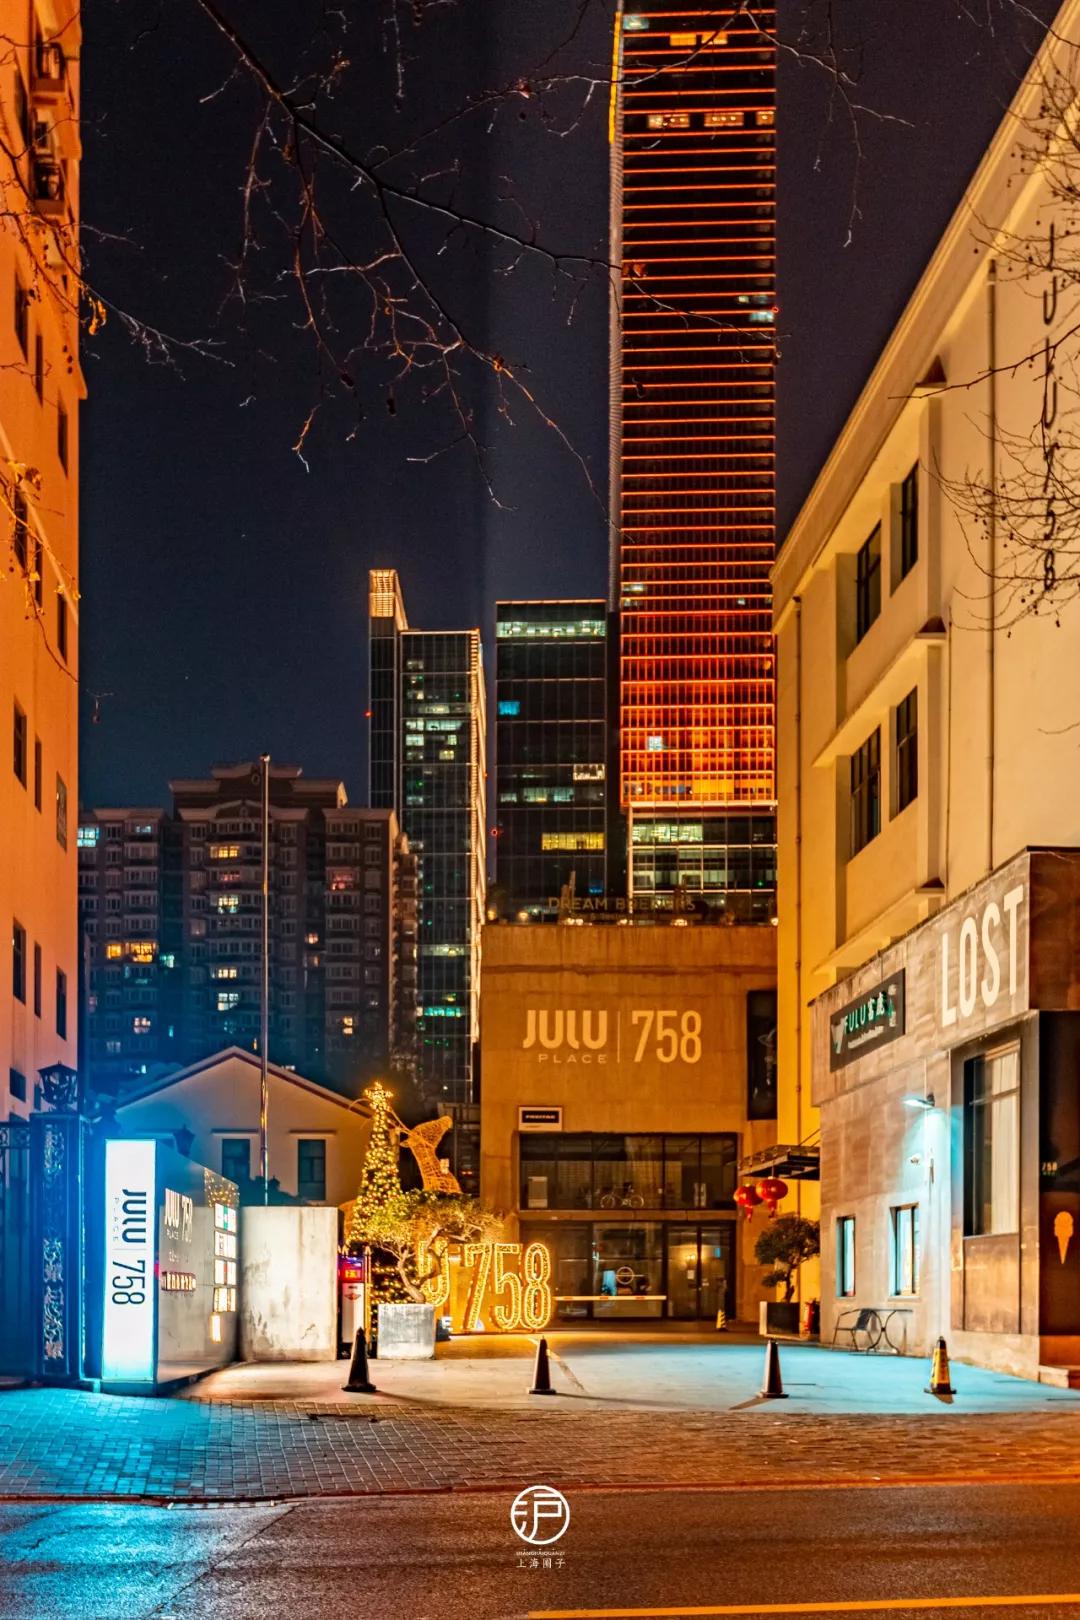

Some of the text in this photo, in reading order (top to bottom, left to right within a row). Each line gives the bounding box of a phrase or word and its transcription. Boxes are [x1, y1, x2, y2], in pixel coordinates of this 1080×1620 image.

[941, 884, 1024, 1028] LOST
[523, 1010, 702, 1064] JULU 758
[538, 1053, 608, 1064] PLACE
[111, 1188, 147, 1305] JULU 758
[464, 1243, 551, 1329] 758
